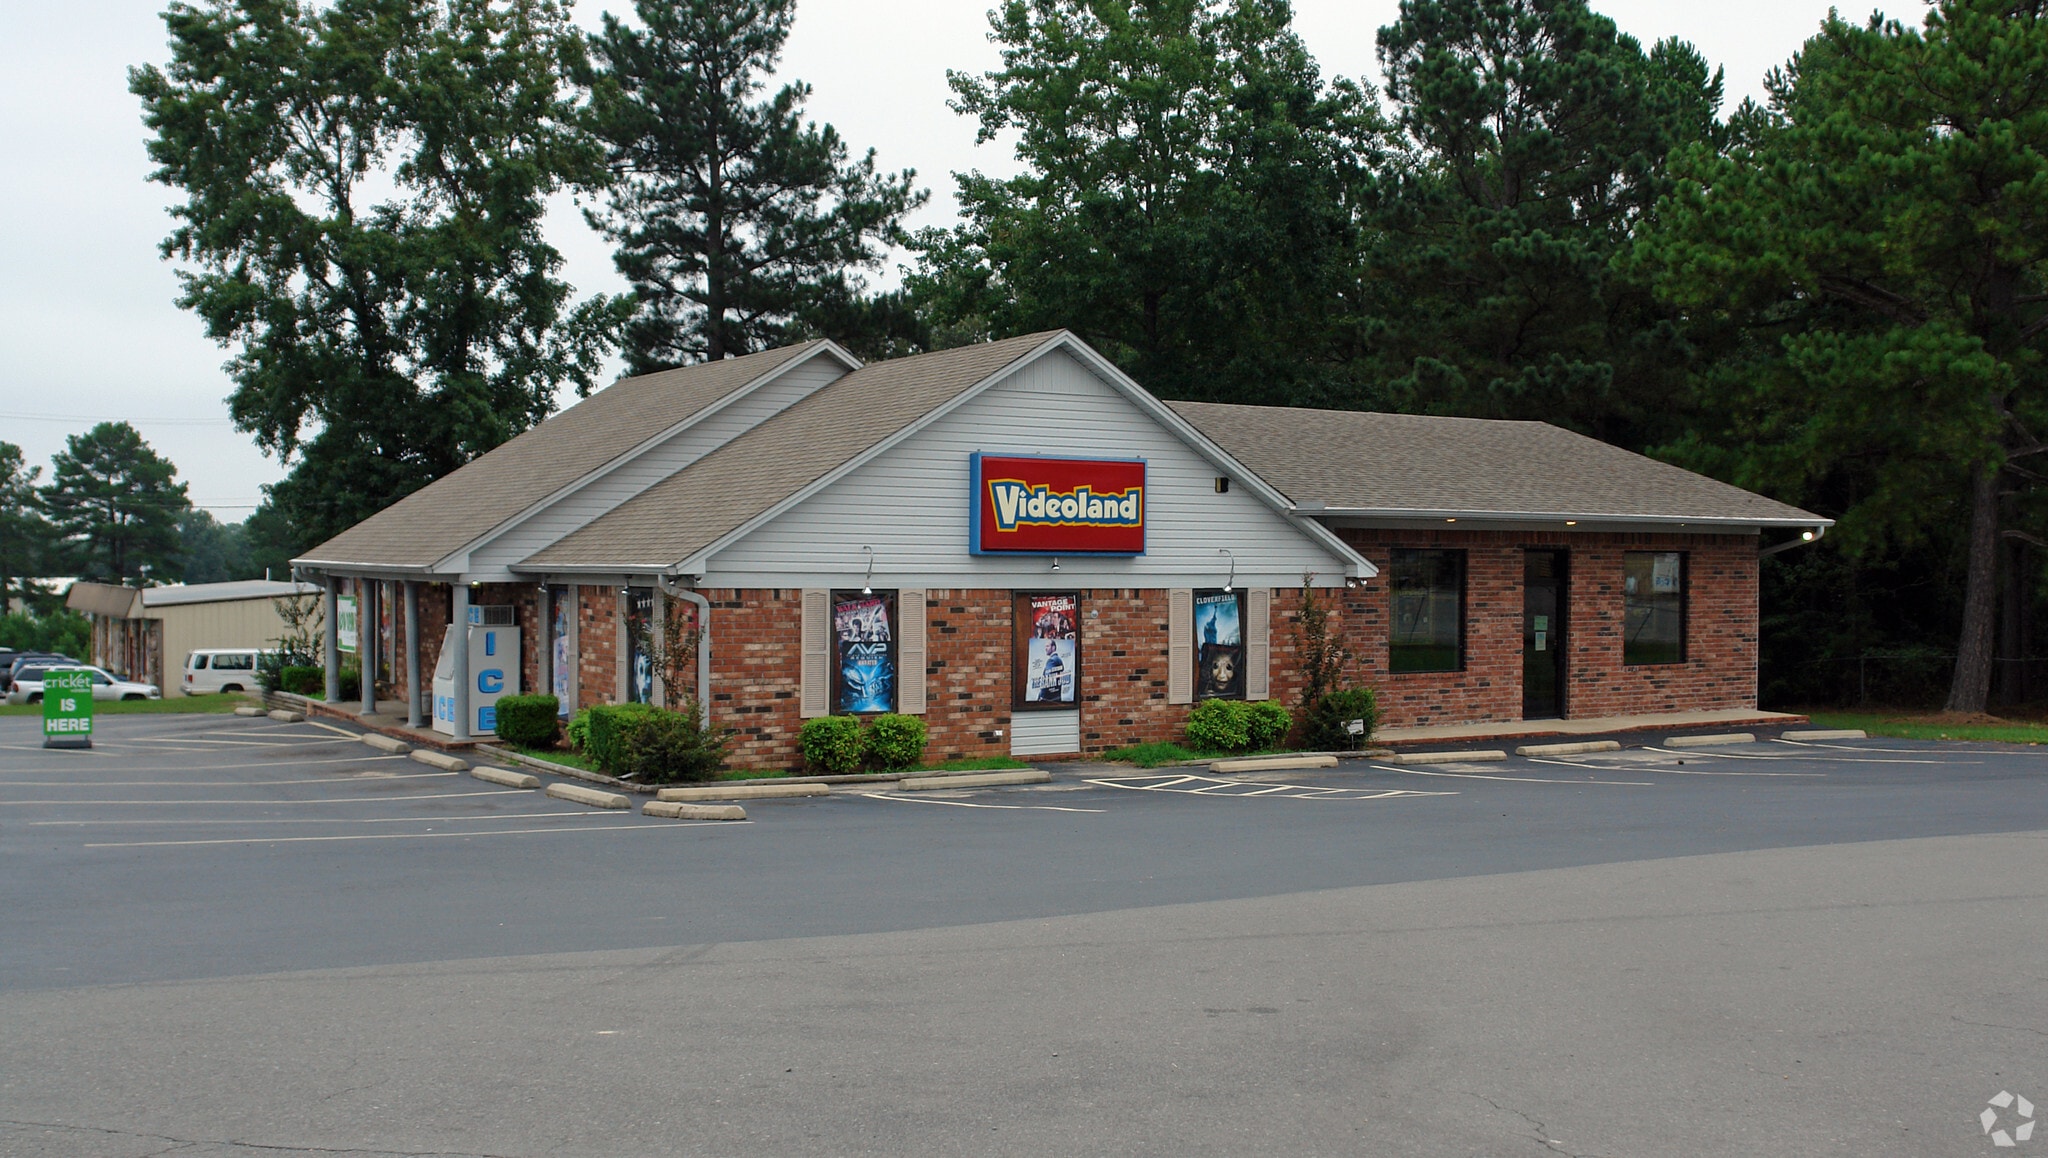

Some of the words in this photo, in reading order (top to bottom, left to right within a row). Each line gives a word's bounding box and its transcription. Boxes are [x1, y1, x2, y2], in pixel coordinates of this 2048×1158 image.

[995, 485, 1137, 525] Videoland
[1031, 598, 1068, 609] VANTAGE
[1196, 594, 1235, 605] CLOVERFIELD
[1051, 603, 1076, 612] POINT
[468, 607, 480, 624] CE
[847, 642, 887, 655] AVP
[44, 673, 91, 688] cricket
[478, 631, 504, 731] ICE
[60, 698, 77, 712] IS
[433, 694, 455, 723] ICE
[46, 718, 90, 732] HERE
